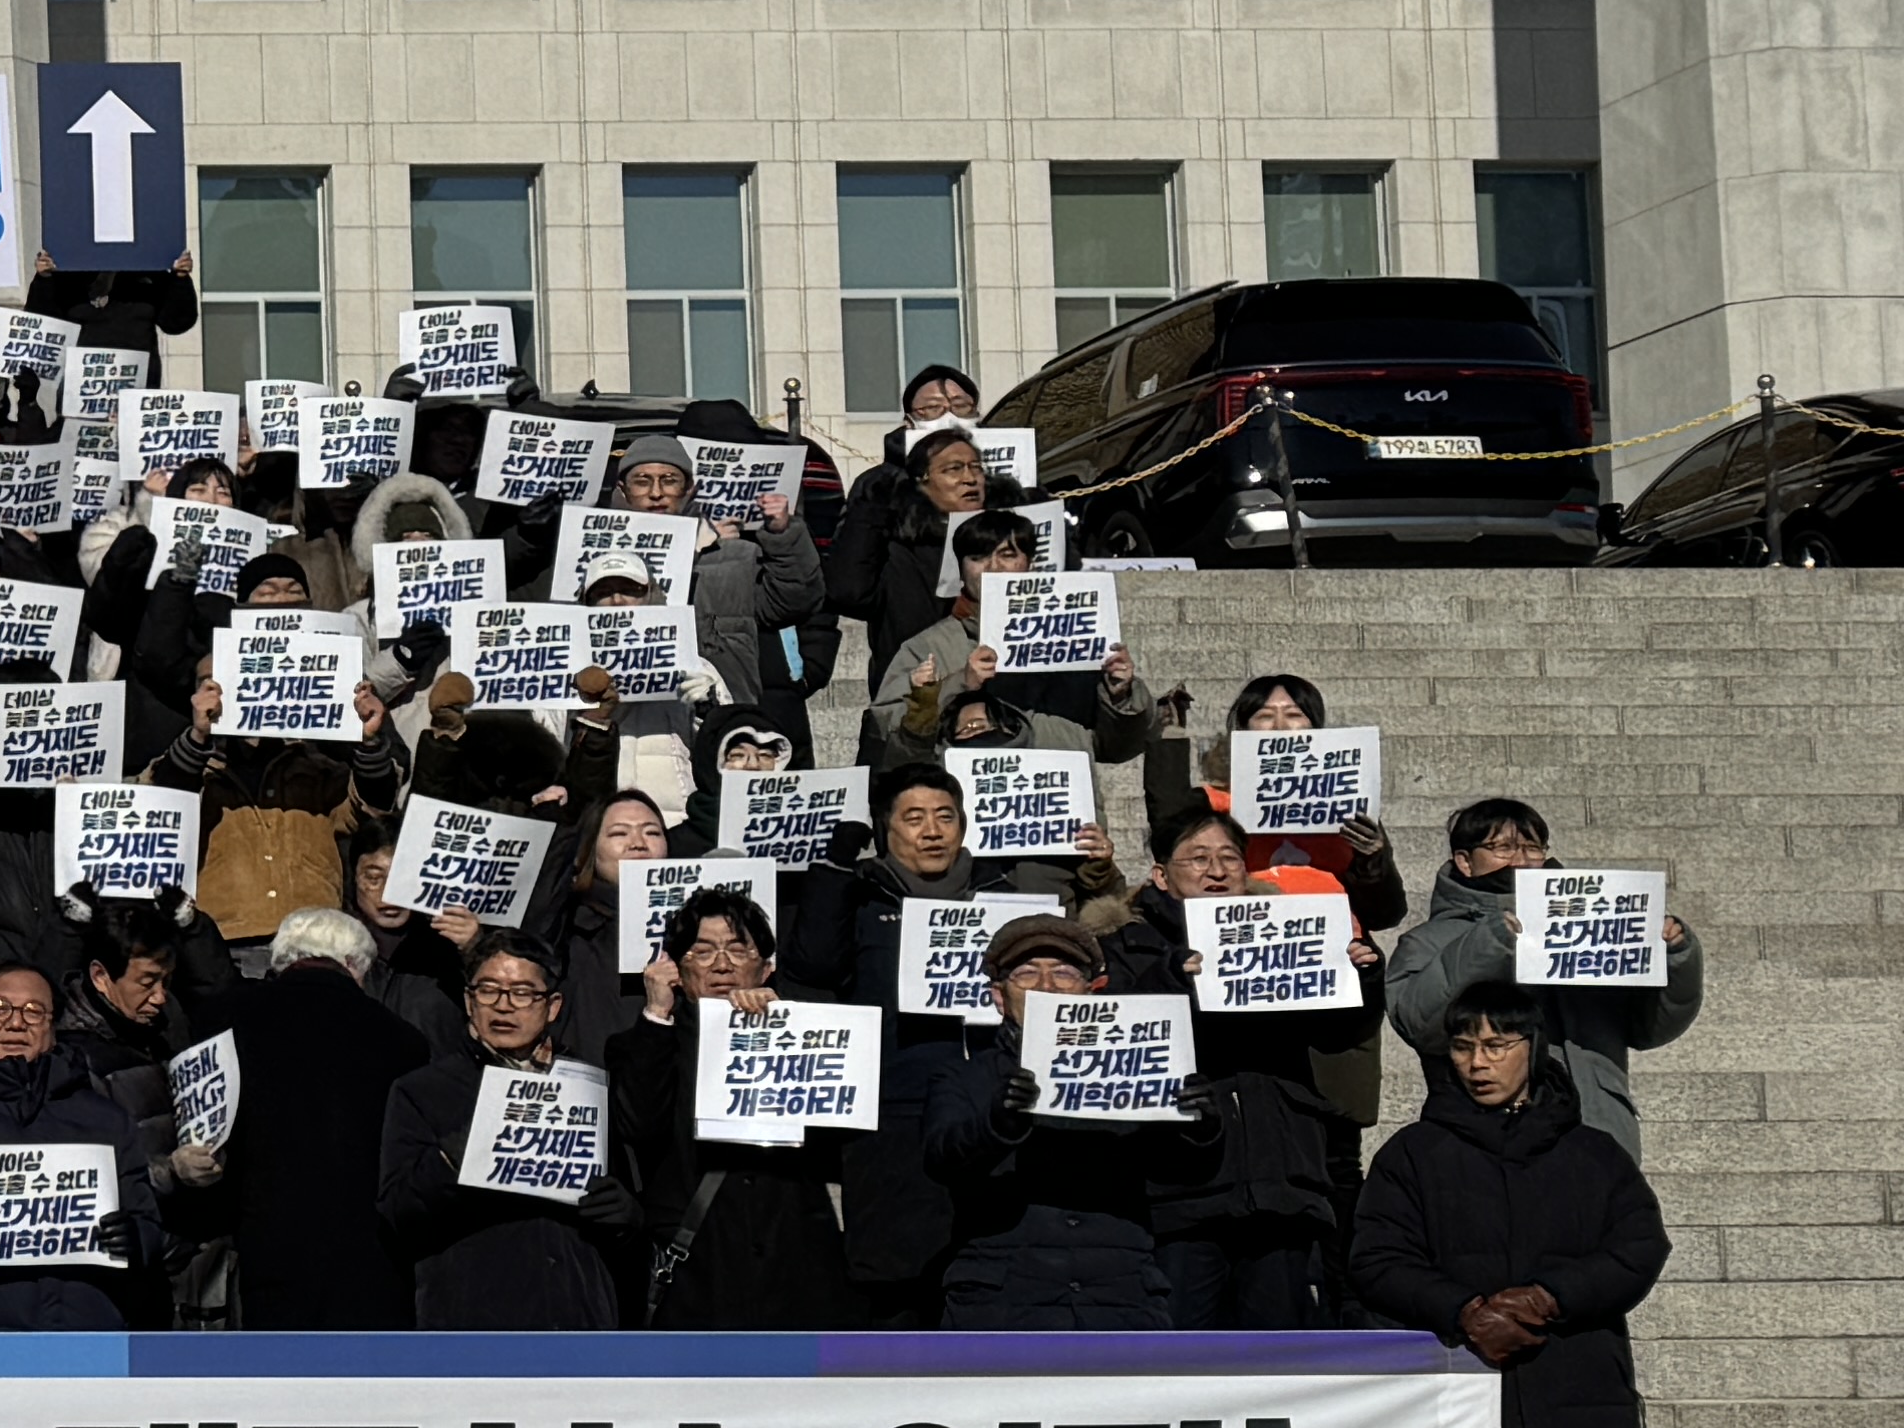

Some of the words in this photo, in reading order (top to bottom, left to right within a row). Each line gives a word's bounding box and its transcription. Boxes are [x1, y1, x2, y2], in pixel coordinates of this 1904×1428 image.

[1006, 577, 1055, 596] 더이상
[1044, 595, 1060, 611] 수
[1003, 611, 1097, 642] 선거제도
[238, 636, 290, 654] 더이상
[1004, 637, 1103, 667] 개혁하라!
[240, 656, 274, 674] 늦출
[277, 655, 295, 673] 수
[299, 655, 339, 672] 없다!
[4, 689, 55, 709] 더이상
[236, 675, 334, 702] 선거제도
[6, 709, 40, 729] 늦출
[44, 708, 61, 725] 수
[65, 702, 102, 723] 없다!
[237, 703, 341, 730] 개혁하라!
[3, 723, 99, 756] 선거제도
[1545, 875, 1604, 896] 더이상
[1215, 901, 1271, 924] 더이상
[1547, 897, 1586, 918] 늦출
[1591, 896, 1610, 915] 수
[1614, 893, 1649, 914] 없다!
[1219, 924, 1255, 946] 늦출
[1260, 922, 1278, 941] 수
[1284, 916, 1326, 939] 없다!
[1544, 916, 1646, 949] 선거제도
[1217, 939, 1323, 977] 선거제도
[1546, 946, 1652, 979] 개혁하라!
[1223, 969, 1334, 1006] 개혁하라!
